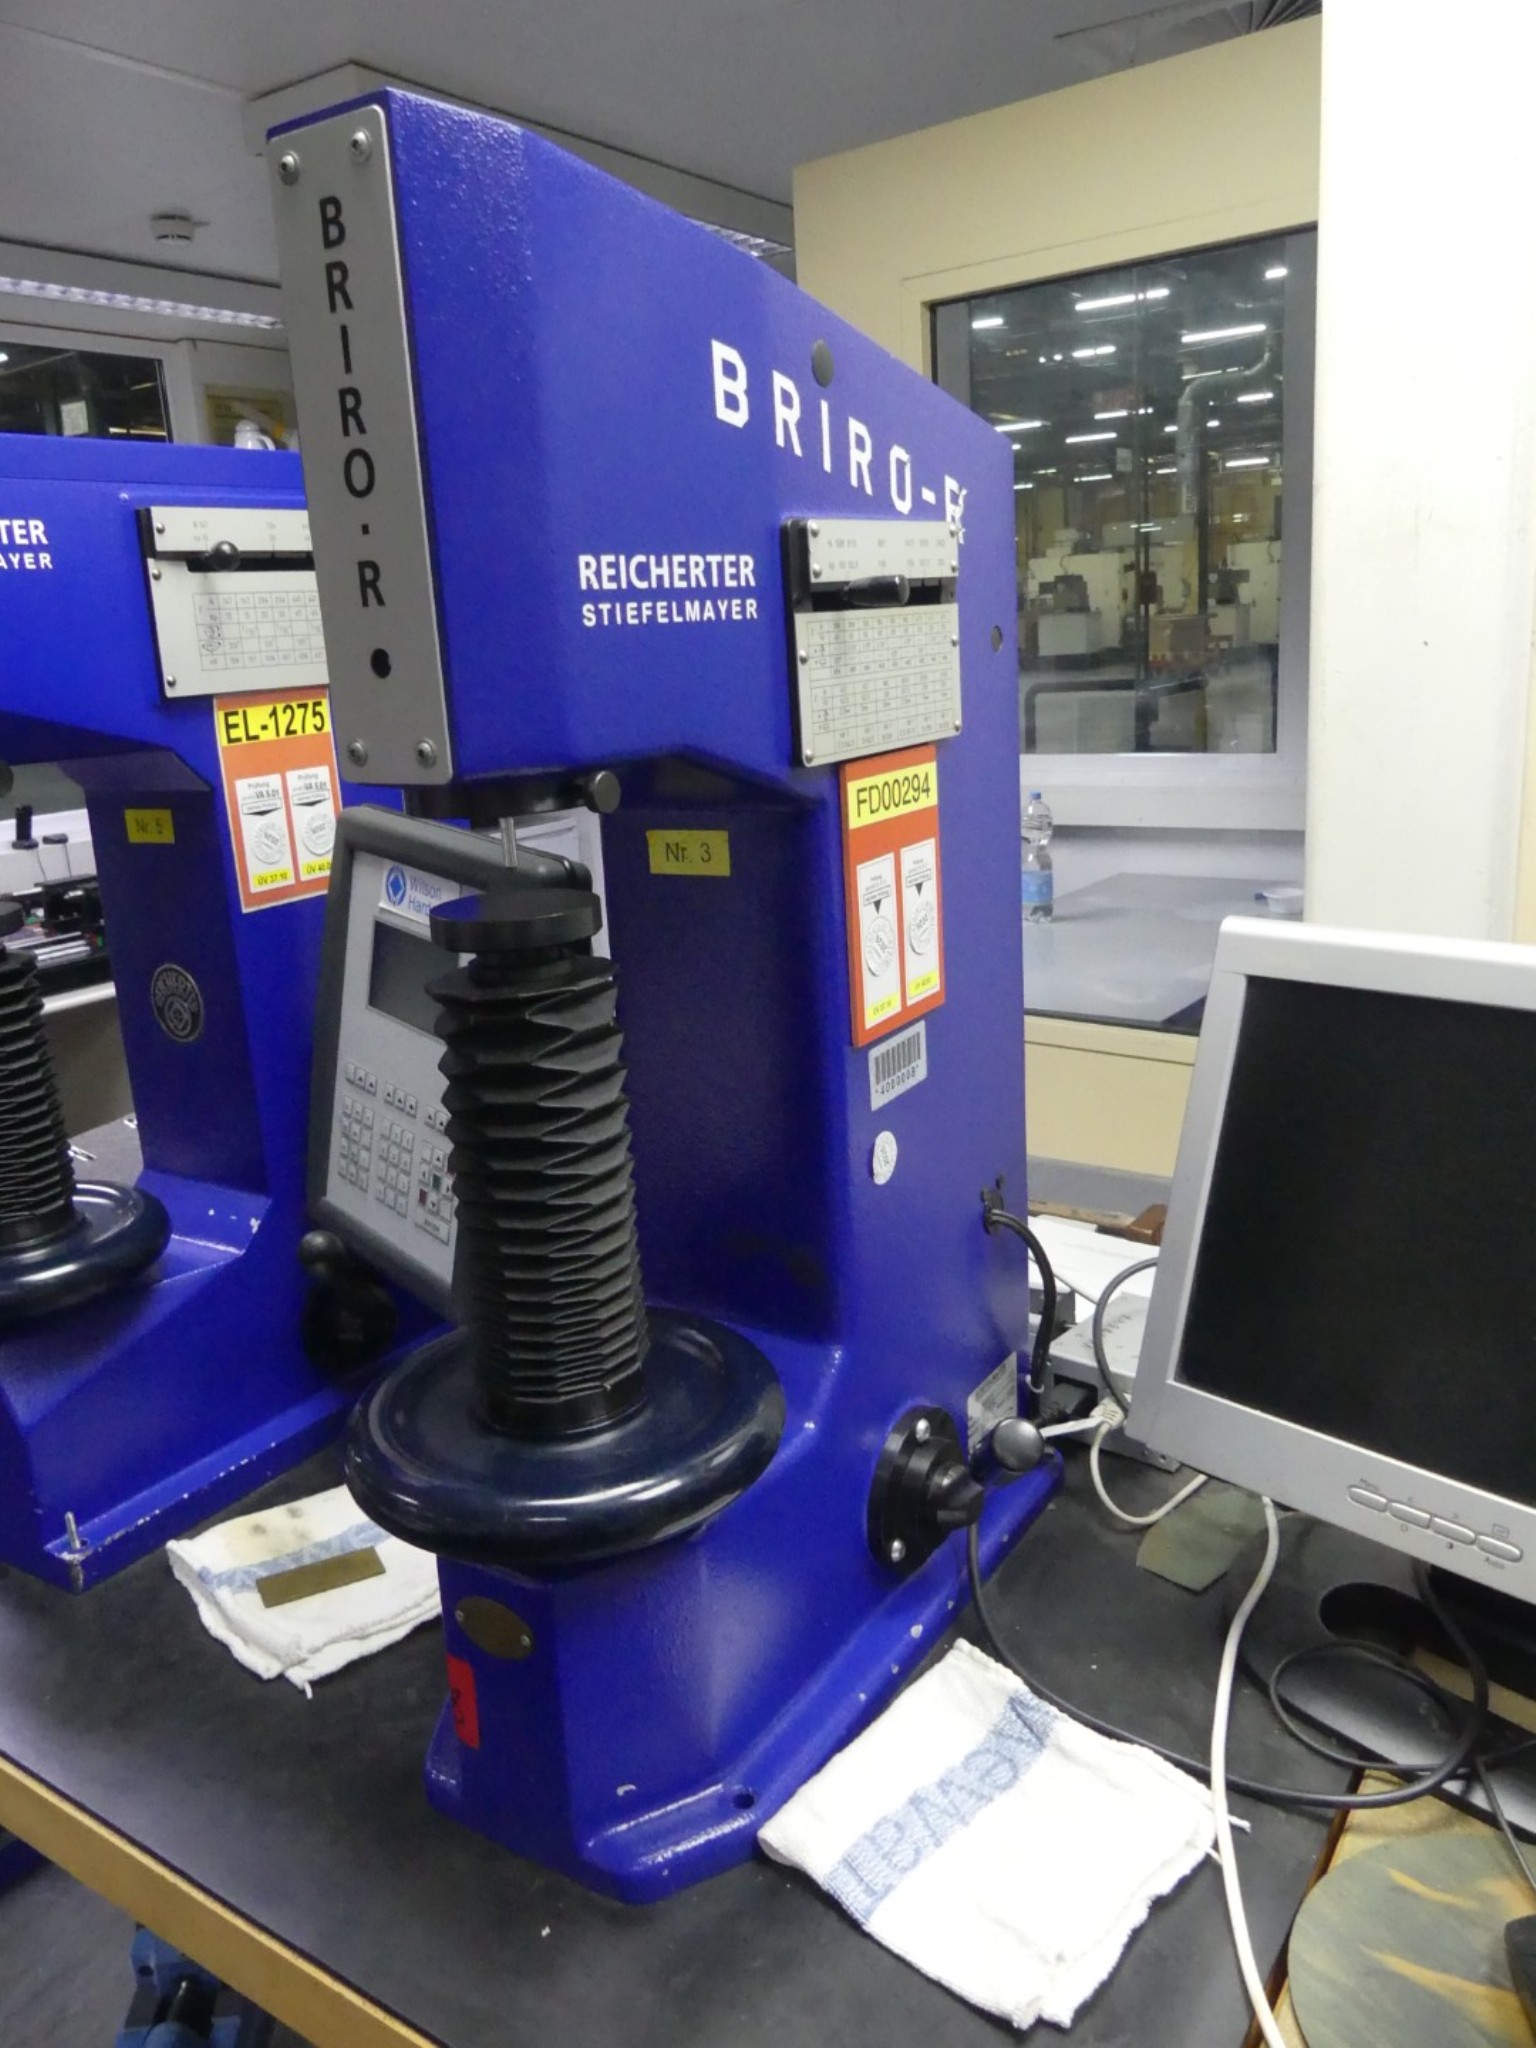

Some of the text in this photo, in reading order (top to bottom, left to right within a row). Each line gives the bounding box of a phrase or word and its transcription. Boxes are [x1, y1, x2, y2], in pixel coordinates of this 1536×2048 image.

[579, 555, 756, 590] REICHERTER
[582, 598, 757, 627] STIEFELMAYER
[224, 701, 325, 744] EL-1275
[856, 772, 930, 818] FD00294
[665, 842, 711, 863] Nr. 3
[410, 877, 441, 898] Wilson
